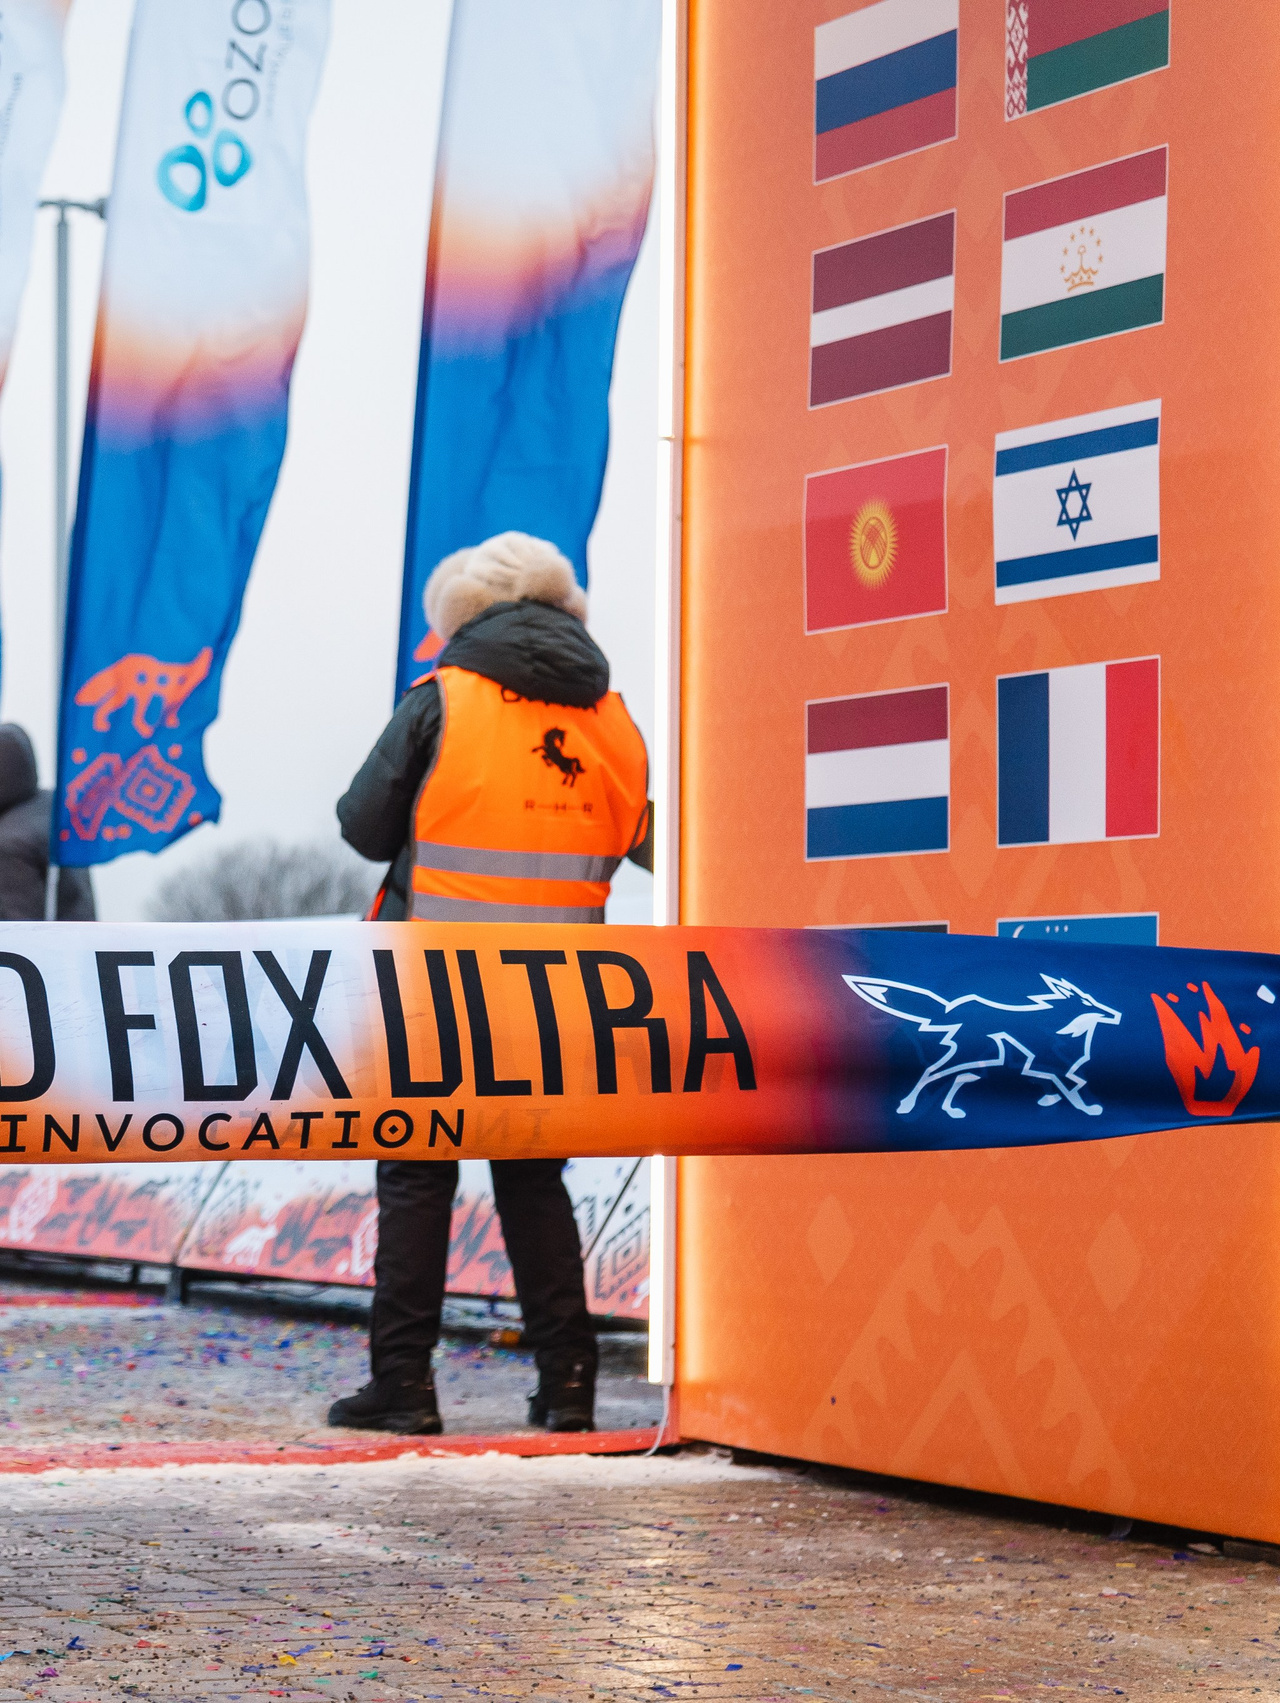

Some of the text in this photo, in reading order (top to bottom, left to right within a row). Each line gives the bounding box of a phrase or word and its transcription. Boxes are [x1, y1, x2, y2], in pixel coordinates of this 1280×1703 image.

[96, 951, 352, 1101] FOX
[373, 950, 756, 1097] ULTRA
[0, 1110, 463, 1152] INVOCATION
